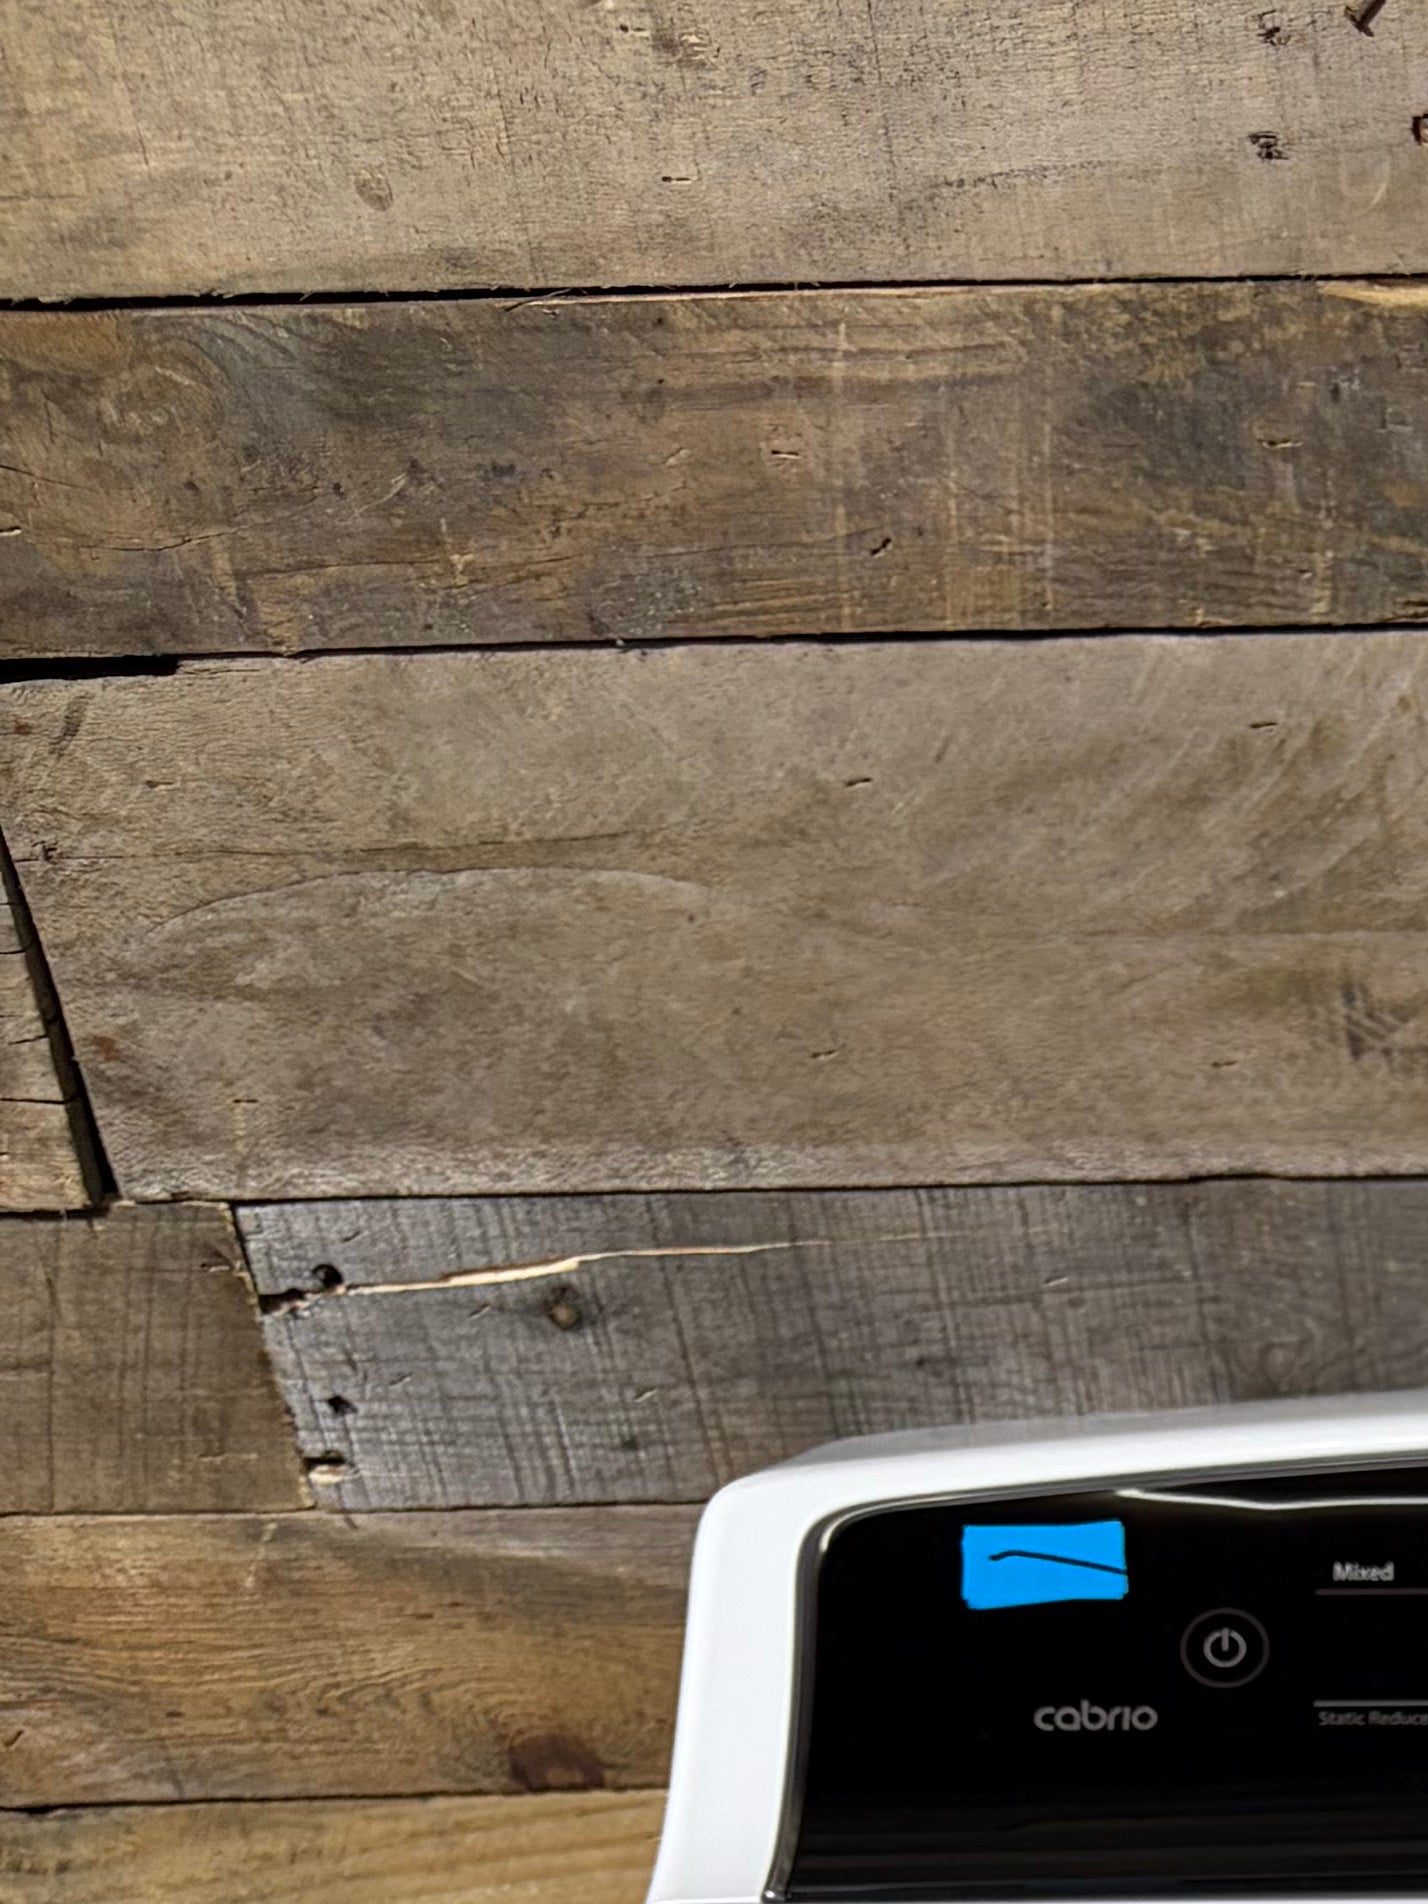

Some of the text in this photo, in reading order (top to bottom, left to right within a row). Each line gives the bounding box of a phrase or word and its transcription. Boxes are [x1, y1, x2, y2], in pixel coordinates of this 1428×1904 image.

[1331, 1560, 1395, 1582] Mixed
[1033, 1698, 1159, 1732] cabrio
[1317, 1710, 1366, 1727] Static
